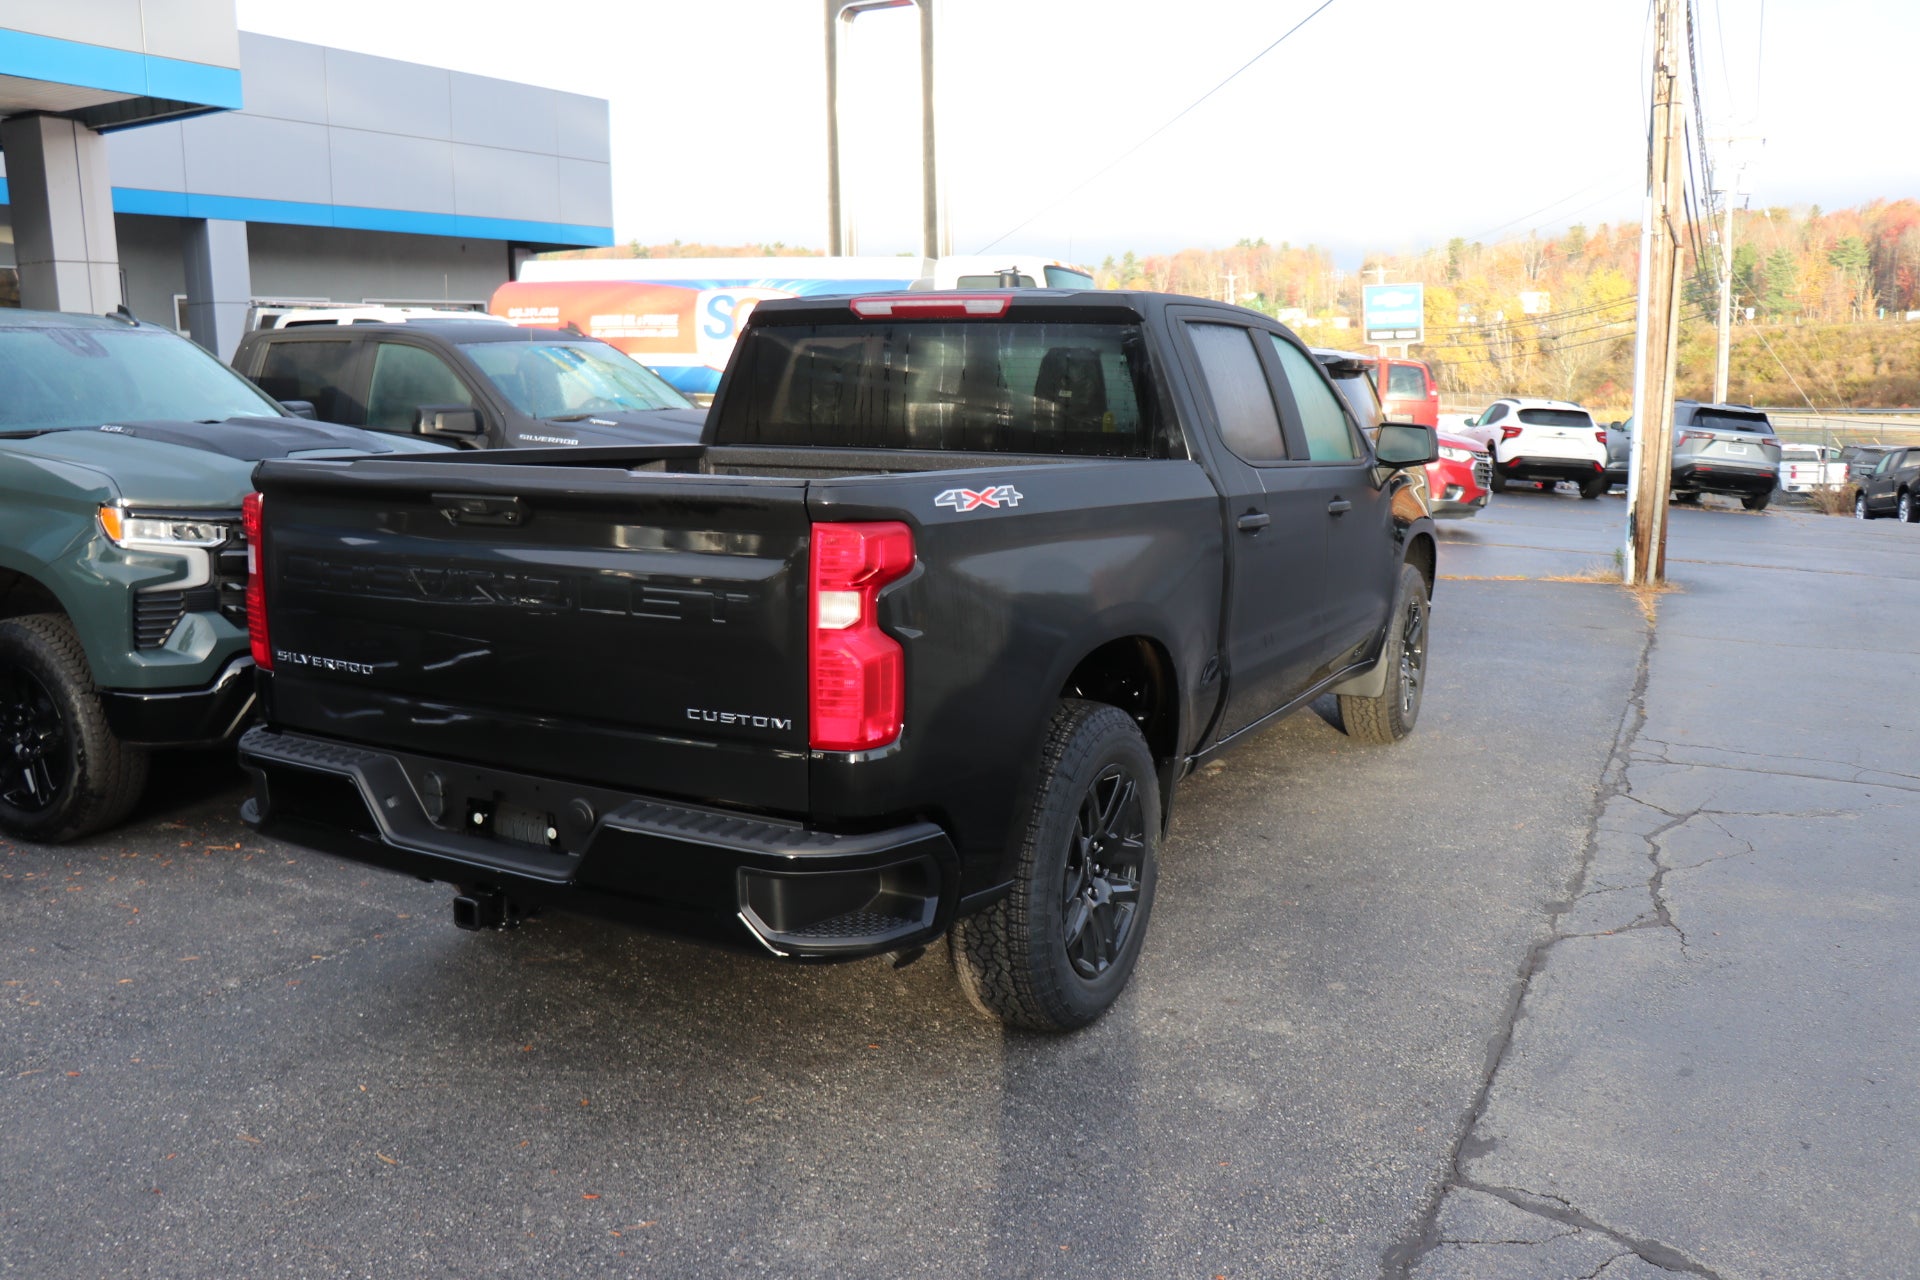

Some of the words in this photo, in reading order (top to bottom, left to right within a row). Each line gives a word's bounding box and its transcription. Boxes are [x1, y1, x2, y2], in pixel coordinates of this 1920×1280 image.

[519, 433, 579, 446] SILVERADO
[277, 649, 374, 675] SILVERADO
[687, 708, 793, 730] CUSTOM
